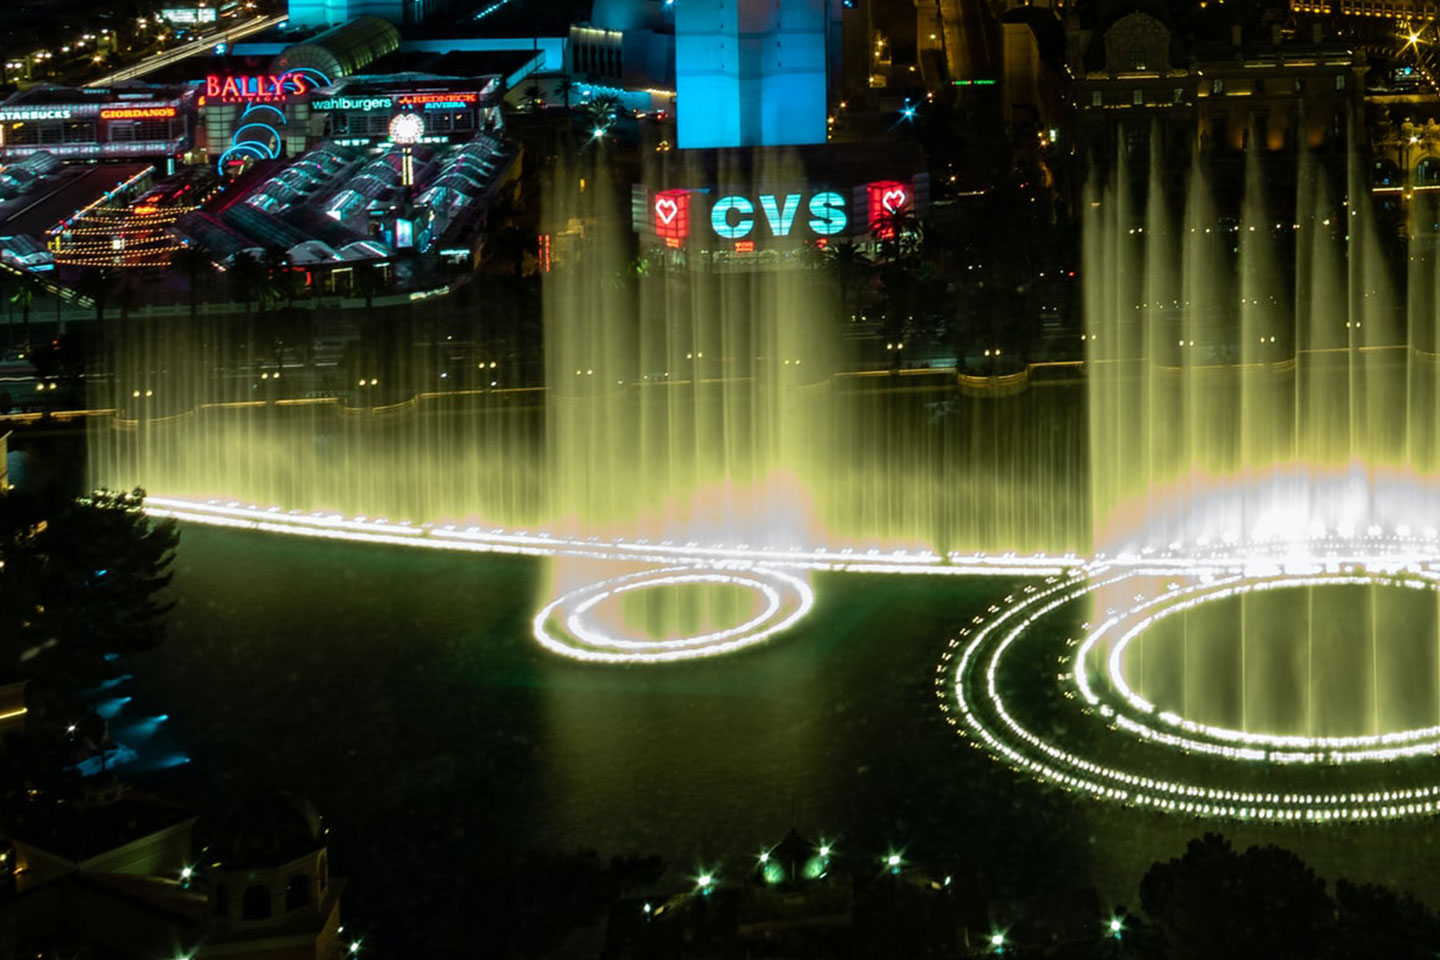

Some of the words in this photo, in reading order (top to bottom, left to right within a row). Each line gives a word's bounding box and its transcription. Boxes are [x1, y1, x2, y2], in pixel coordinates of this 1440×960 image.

[206, 72, 307, 97] BALLY'S
[312, 97, 392, 112] wahlburgers
[413, 94, 476, 104] REDNECK
[425, 101, 466, 109] RIVIERA
[0, 109, 71, 121] STARBUCKS
[101, 108, 176, 119] GIORDANO'S
[710, 191, 848, 239] CVS
